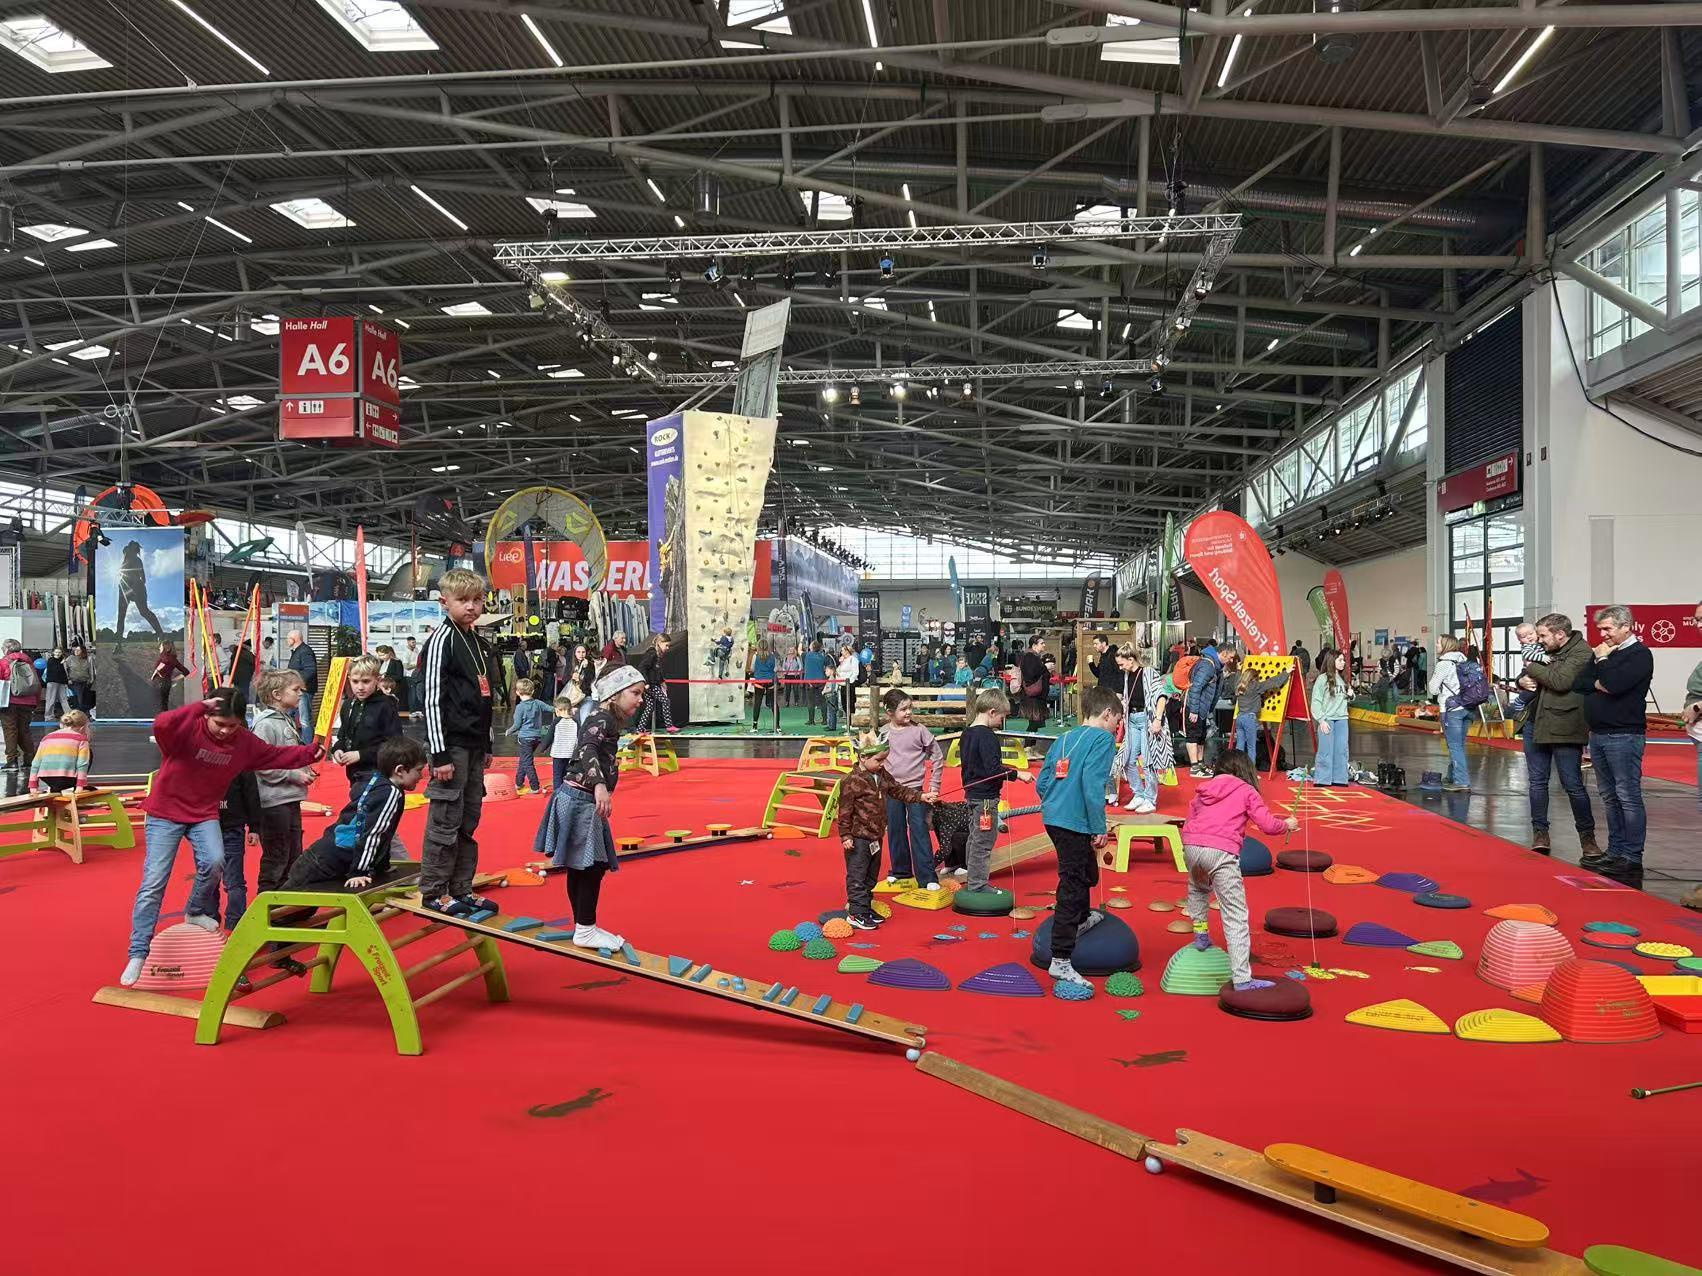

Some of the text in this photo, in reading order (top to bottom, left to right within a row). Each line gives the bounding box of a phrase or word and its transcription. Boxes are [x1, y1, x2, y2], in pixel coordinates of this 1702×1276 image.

[285, 321, 328, 330] Halle Hall
[297, 342, 350, 376] A6
[371, 351, 398, 389] A6
[195, 749, 233, 765] PUMA
